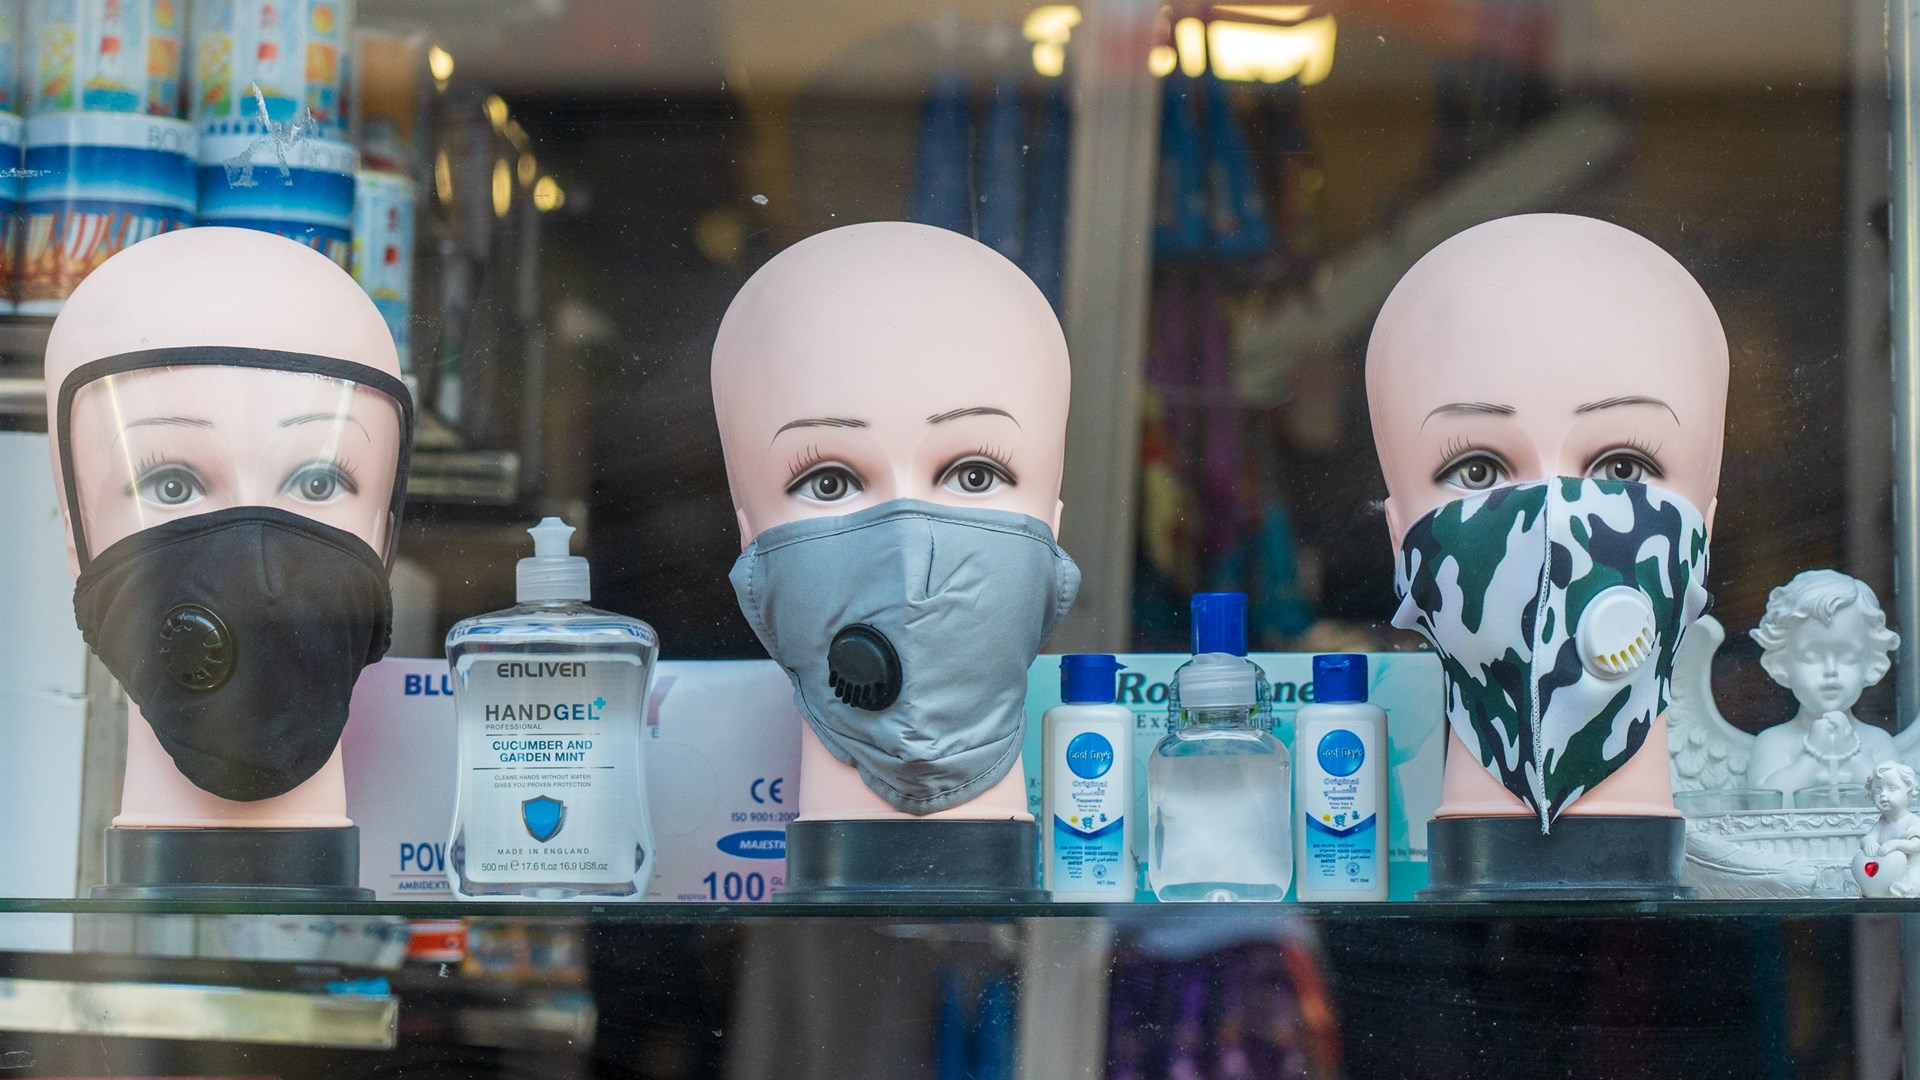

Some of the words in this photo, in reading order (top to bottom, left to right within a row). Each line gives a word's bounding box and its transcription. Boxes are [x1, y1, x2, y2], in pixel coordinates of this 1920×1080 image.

[497, 662, 586, 678] ENLIVEN
[492, 741, 563, 751] CUCUMBER
[567, 740, 593, 750] AND
[499, 752, 551, 762] GARDEN
[555, 752, 586, 762] MINT
[1070, 751, 1088, 759] Cool
[1321, 749, 1338, 758] Cool
[732, 812, 748, 822] ISO
[739, 839, 786, 849] MAJESTI
[481, 862, 497, 872] 500
[498, 862, 508, 871] ml
[522, 862, 539, 871] 17.6
[560, 861, 578, 870] 16.9
[703, 871, 765, 901] 100
